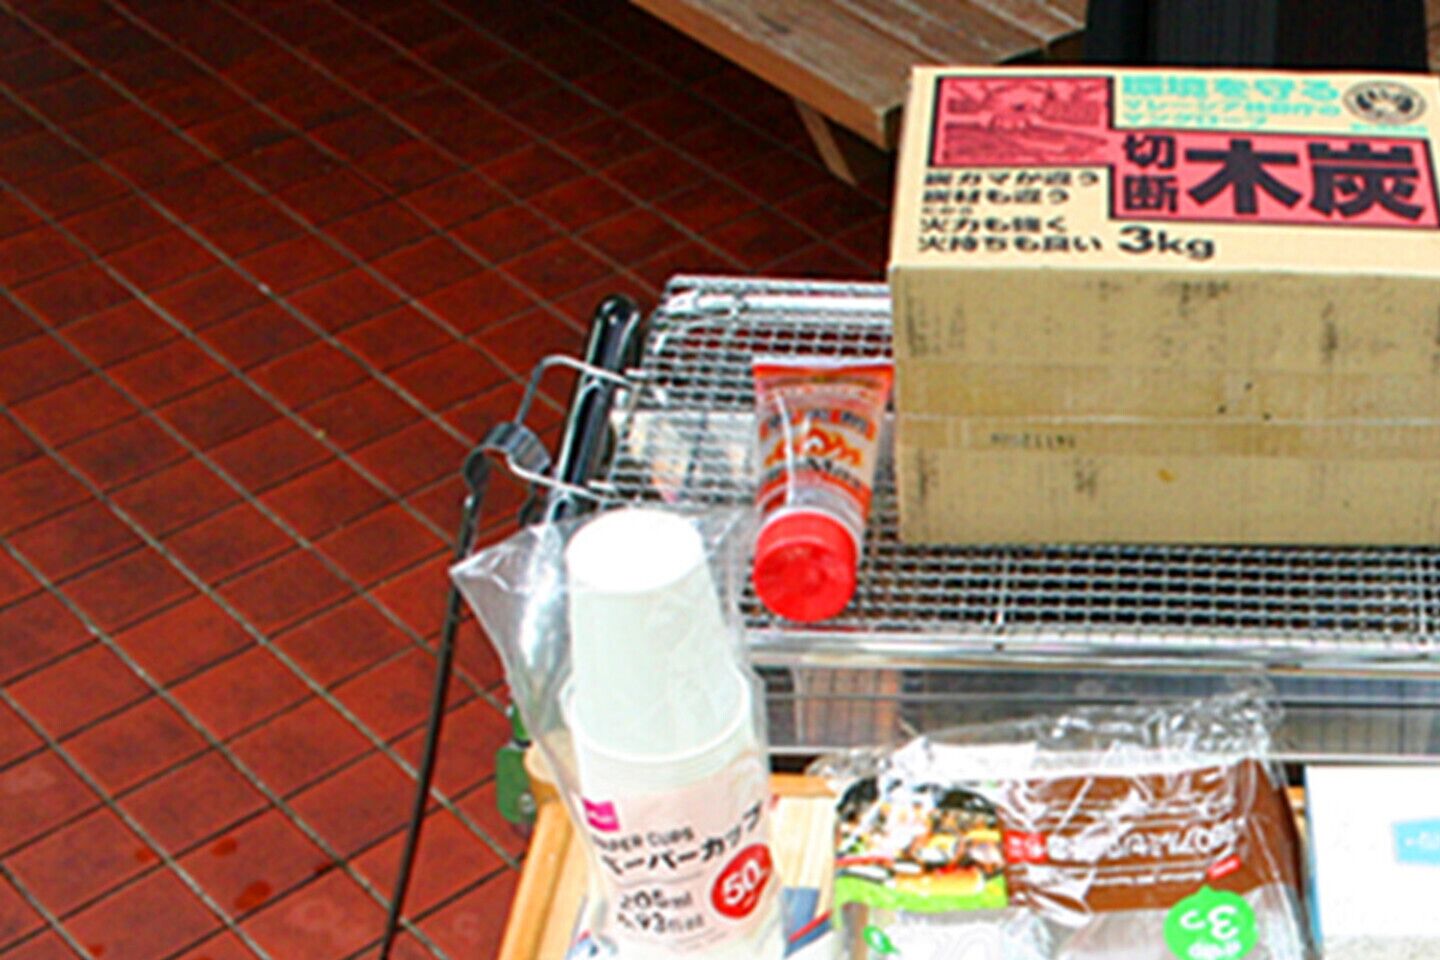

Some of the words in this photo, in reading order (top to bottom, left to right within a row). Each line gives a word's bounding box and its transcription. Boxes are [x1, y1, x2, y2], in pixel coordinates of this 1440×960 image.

[1184, 138, 1426, 220] 木炭
[1117, 224, 1215, 260] 3kg
[723, 859, 764, 906] 50
